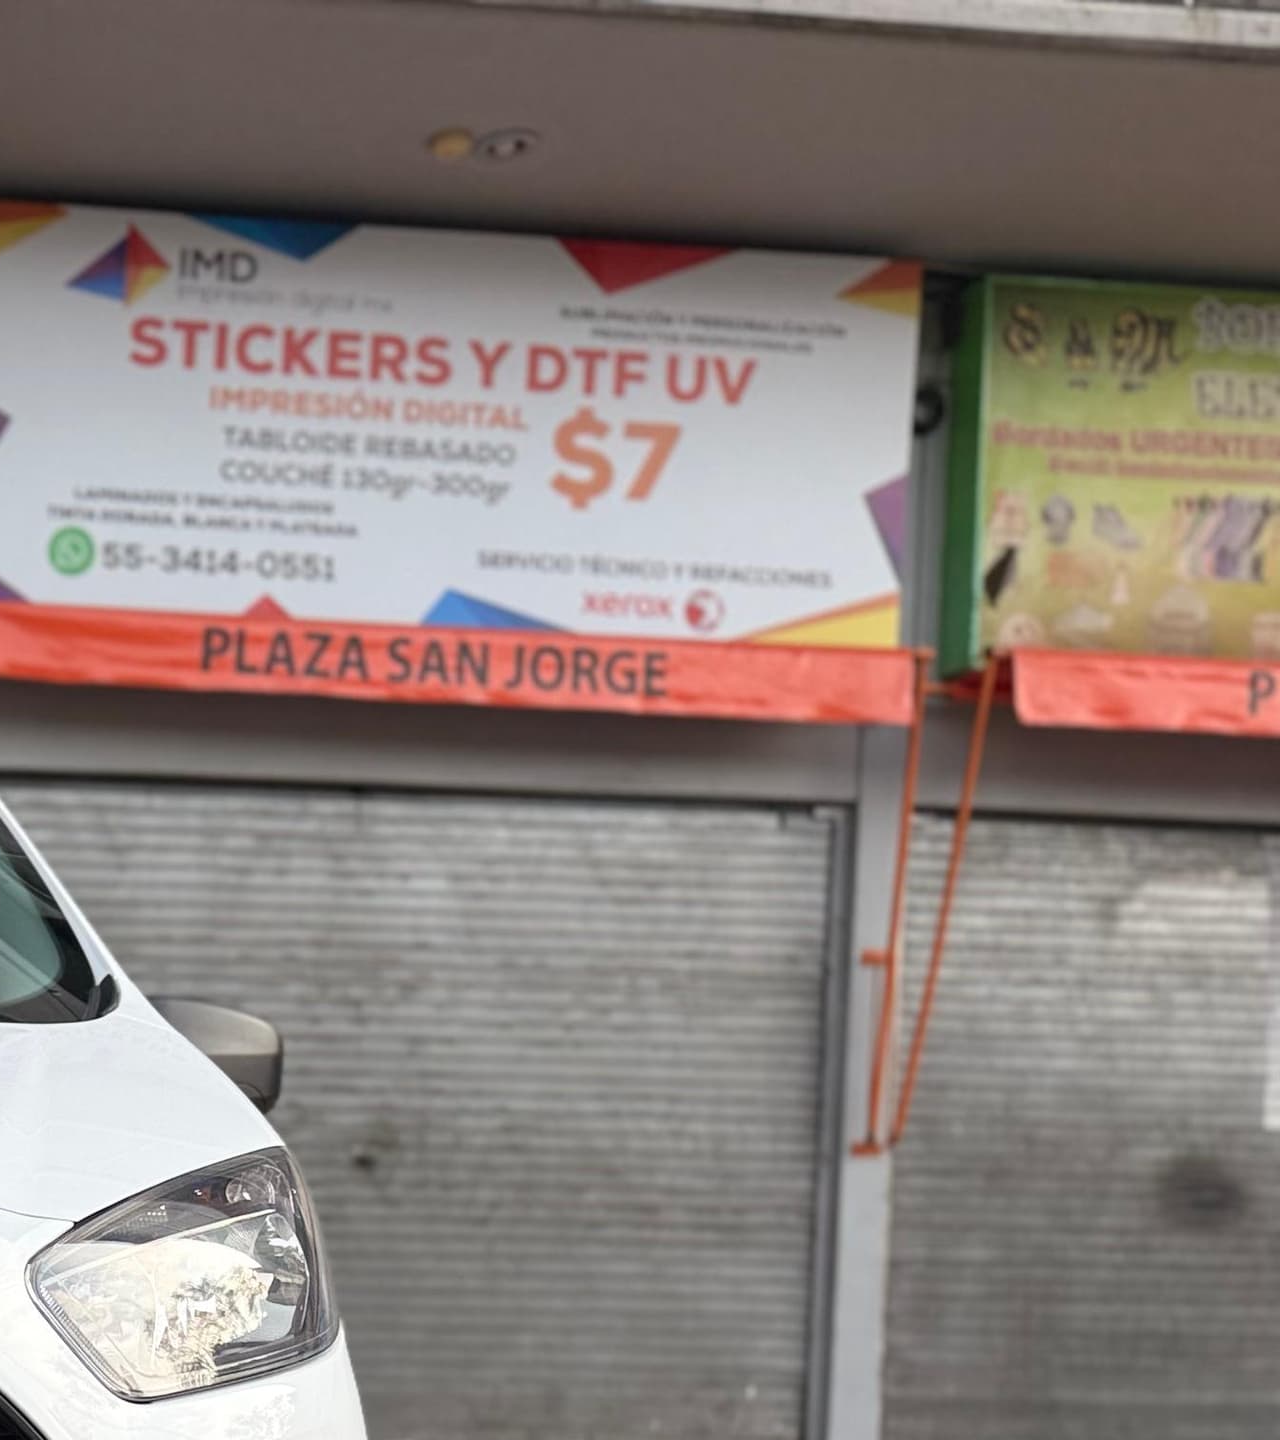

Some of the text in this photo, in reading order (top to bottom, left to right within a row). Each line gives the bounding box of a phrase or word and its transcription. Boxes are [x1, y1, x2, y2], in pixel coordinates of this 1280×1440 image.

[178, 248, 259, 284] IMD
[129, 314, 757, 406] STICKERS Y DTF UV
[209, 385, 530, 433] IMPRESIÓN DIGITAL
[222, 426, 517, 468] TABLOIDE REBASADO
[550, 406, 684, 512] $7
[100, 539, 338, 582] 55-3414-0551
[581, 590, 675, 621] xerox
[200, 626, 669, 698] PLAZA SAN JORGE
